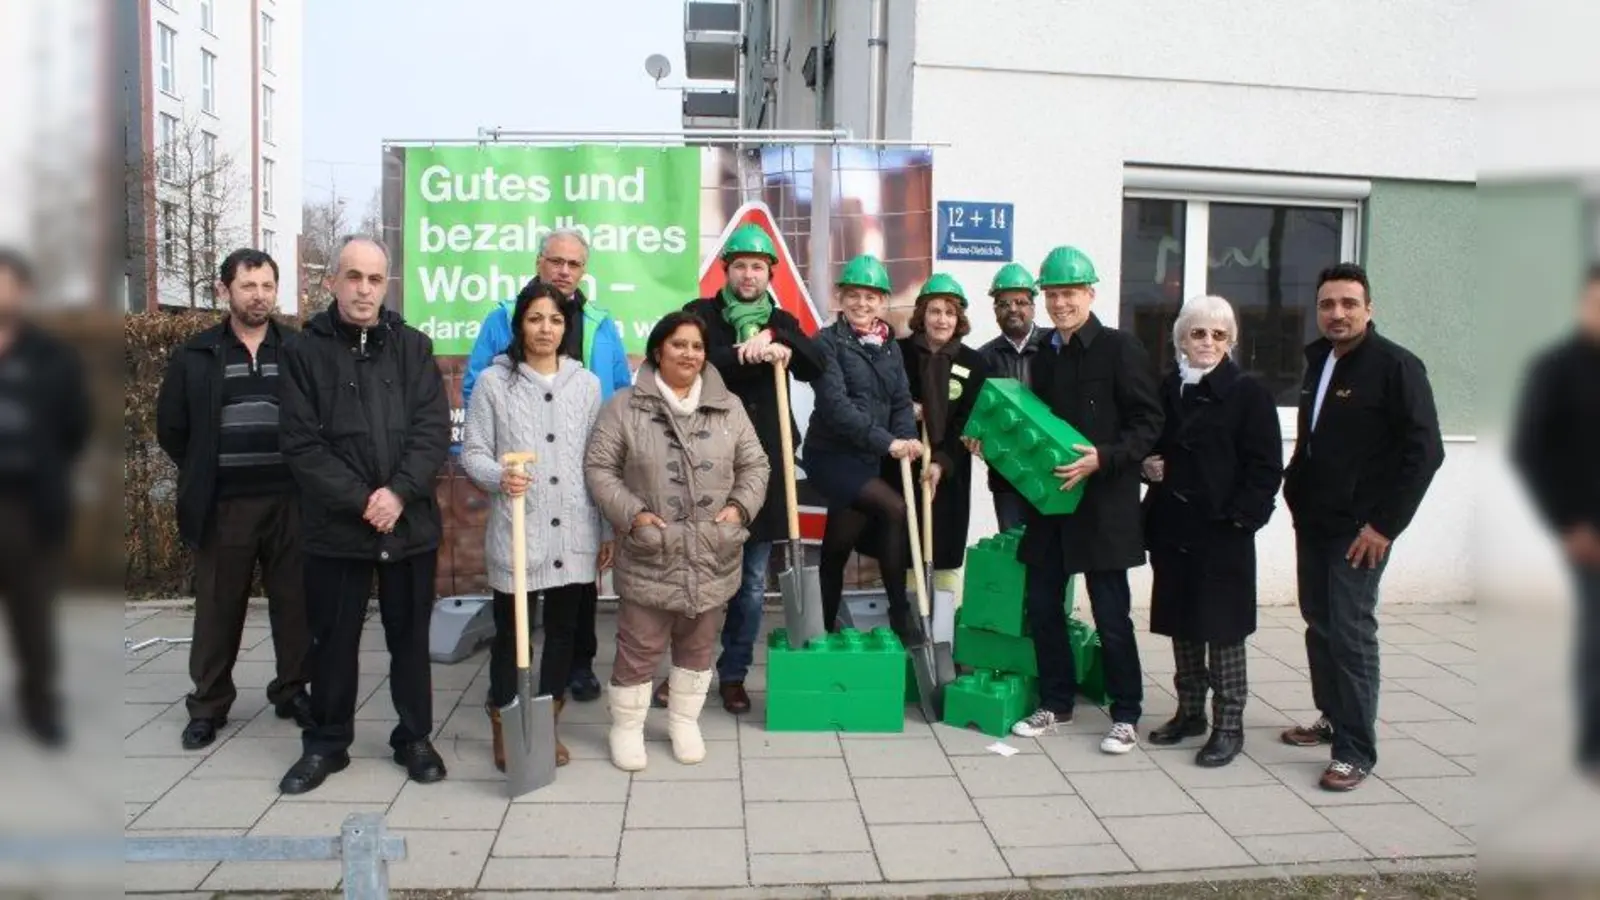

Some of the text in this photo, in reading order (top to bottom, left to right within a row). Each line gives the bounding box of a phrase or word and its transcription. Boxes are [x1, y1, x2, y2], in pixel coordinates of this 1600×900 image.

[420, 165, 645, 203] Gutes und
[948, 207, 1005, 229] 12 + 14
